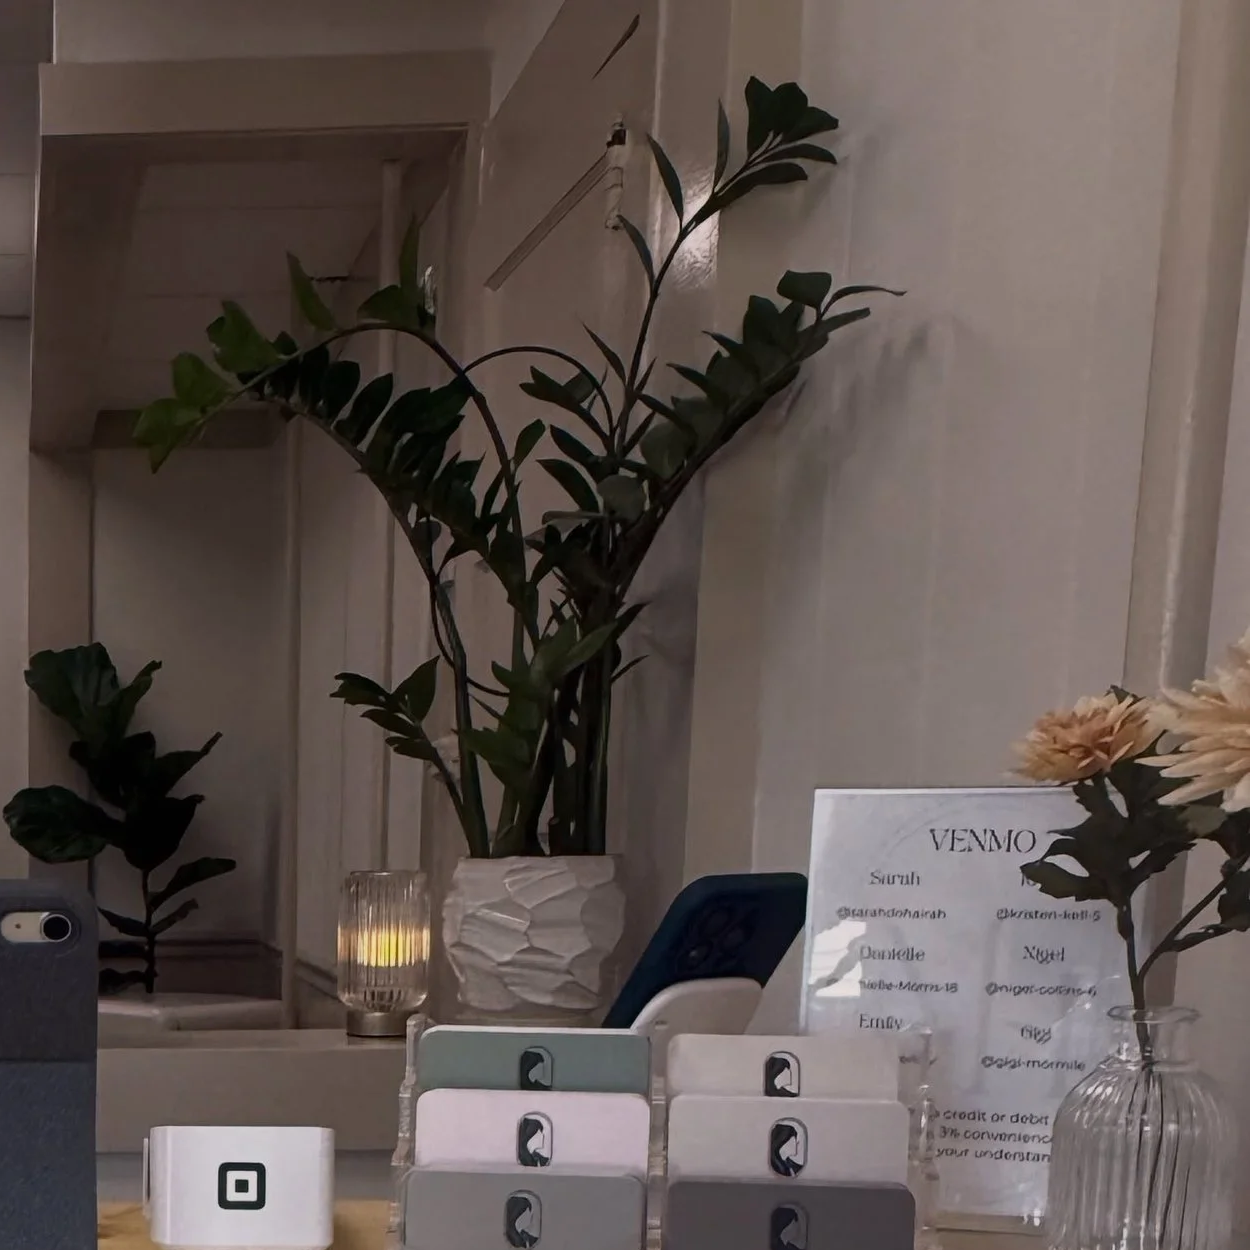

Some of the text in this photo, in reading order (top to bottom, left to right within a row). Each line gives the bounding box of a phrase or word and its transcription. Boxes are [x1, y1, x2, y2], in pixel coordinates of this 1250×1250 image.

[929, 828, 1037, 853] VENMO
[860, 945, 926, 961] Danielle
[963, 1129, 1052, 1144] convenienc
[974, 1149, 1051, 1163] understan
